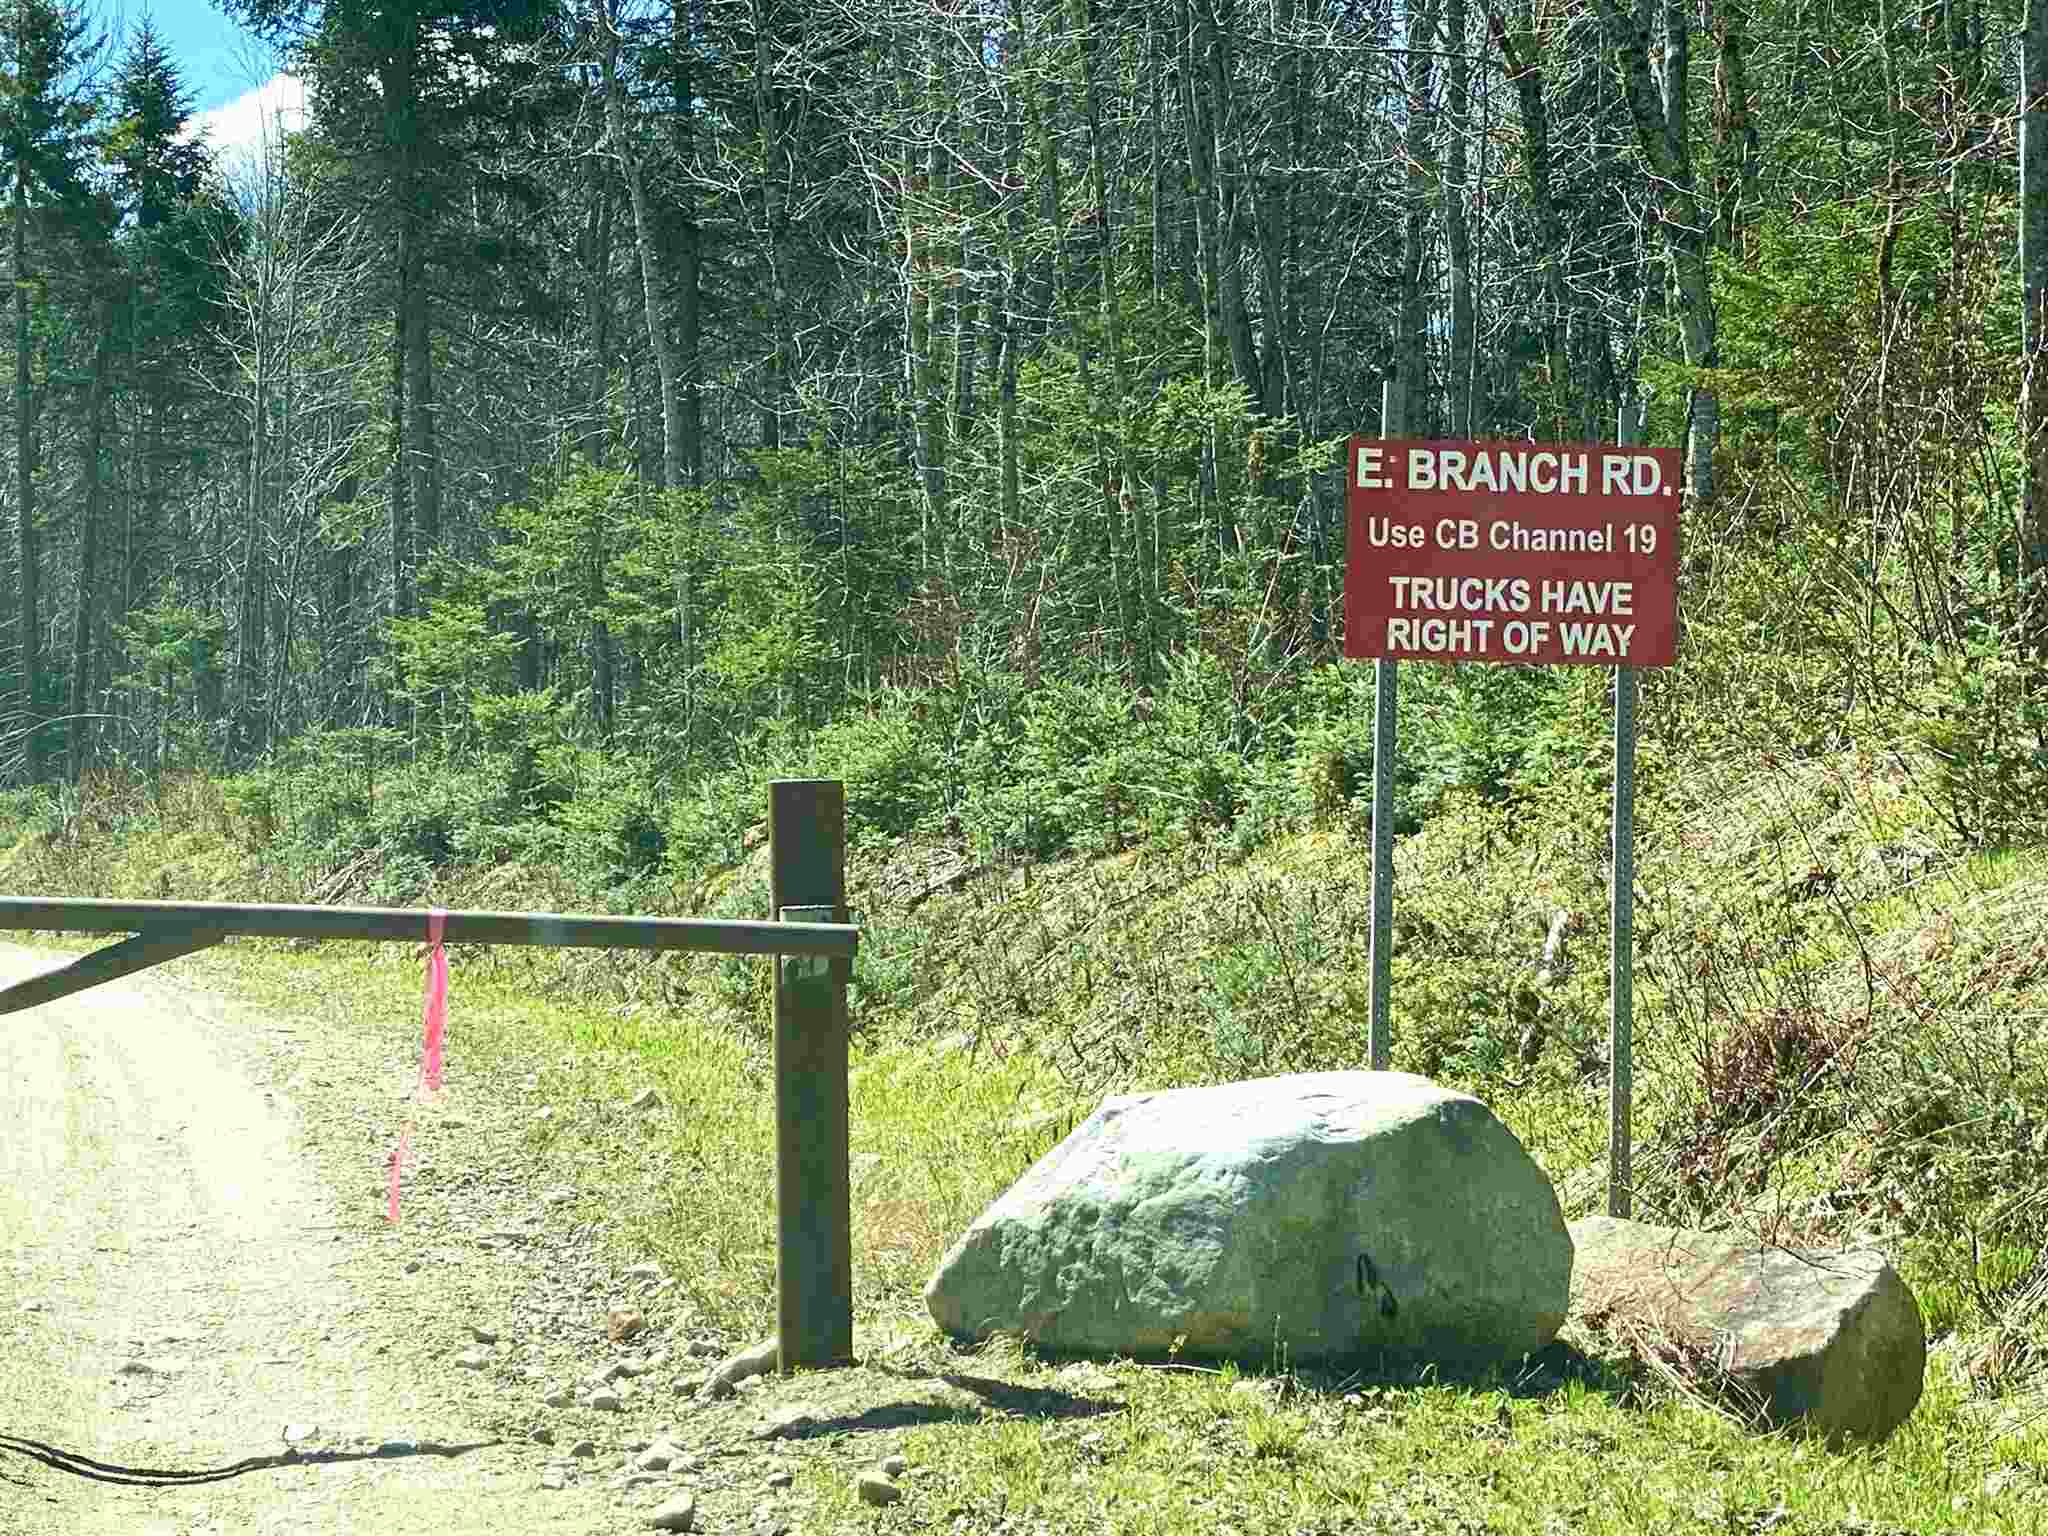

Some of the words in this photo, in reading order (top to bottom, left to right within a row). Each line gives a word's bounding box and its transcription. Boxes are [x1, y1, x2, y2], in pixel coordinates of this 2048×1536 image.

[1407, 448, 1588, 494] BRANCH
[1602, 455, 1672, 497] RD.
[1368, 517, 1425, 548] Use
[1435, 519, 1480, 550] CB
[1489, 521, 1612, 552] Channel
[1623, 524, 1657, 554] 19
[1388, 576, 1530, 613] TRUCKS
[1541, 580, 1633, 616] HAVE
[1386, 618, 1494, 653] RIGHT
[1502, 621, 1549, 655] OF
[1559, 623, 1636, 657] WAY
